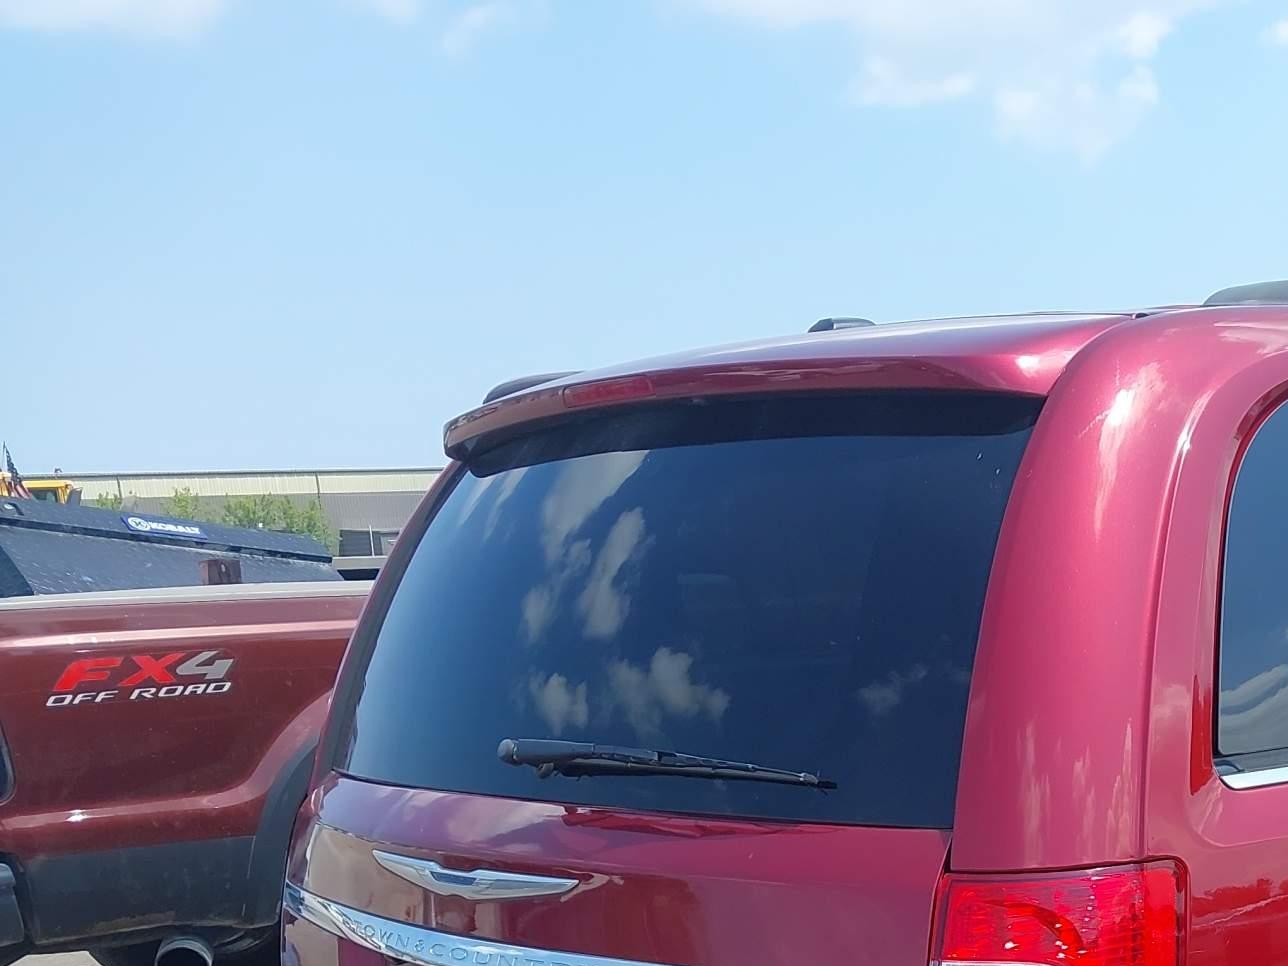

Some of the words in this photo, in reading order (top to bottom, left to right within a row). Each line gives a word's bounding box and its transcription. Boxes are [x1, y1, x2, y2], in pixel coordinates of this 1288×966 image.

[53, 650, 234, 692] FX4
[46, 691, 119, 707] OFF
[129, 682, 232, 700] ROAD
